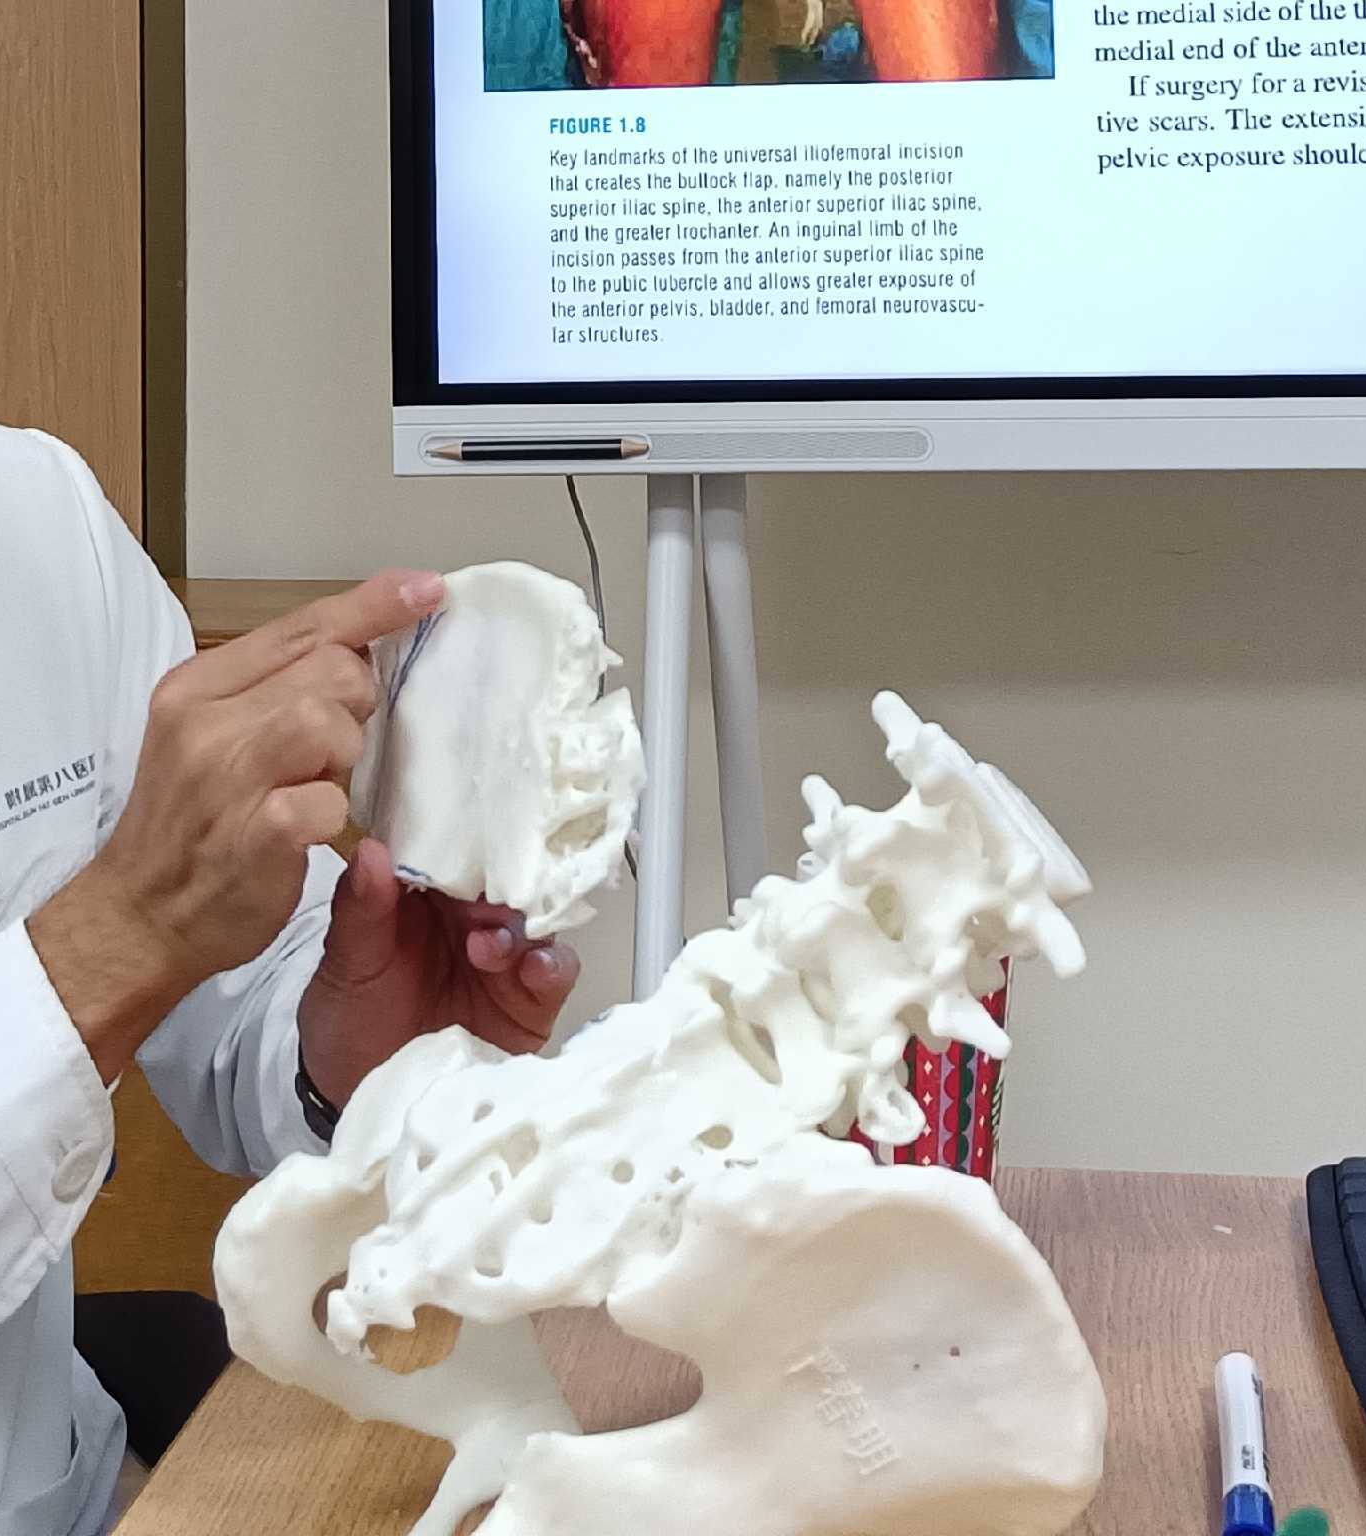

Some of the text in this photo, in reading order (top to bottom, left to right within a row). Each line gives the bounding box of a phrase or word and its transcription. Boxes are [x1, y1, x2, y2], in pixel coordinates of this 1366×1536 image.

[1094, 39, 1174, 62] medial
[1181, 37, 1224, 60] end
[1232, 36, 1260, 59] of
[1265, 36, 1301, 58] the
[548, 116, 646, 135] FIGURE 1.8
[549, 143, 963, 171] Key landmarks of the universal iliofemoral incision
[1097, 146, 1168, 175] pelvic
[1175, 150, 1285, 173] exposure
[549, 203, 616, 221] superior
[621, 199, 656, 216] iliac
[717, 197, 742, 215] the
[747, 196, 811, 214] anterior
[815, 197, 885, 216] superior
[891, 194, 926, 212] iliac
[550, 244, 984, 270] incision passes from the anterior superior iliac spine
